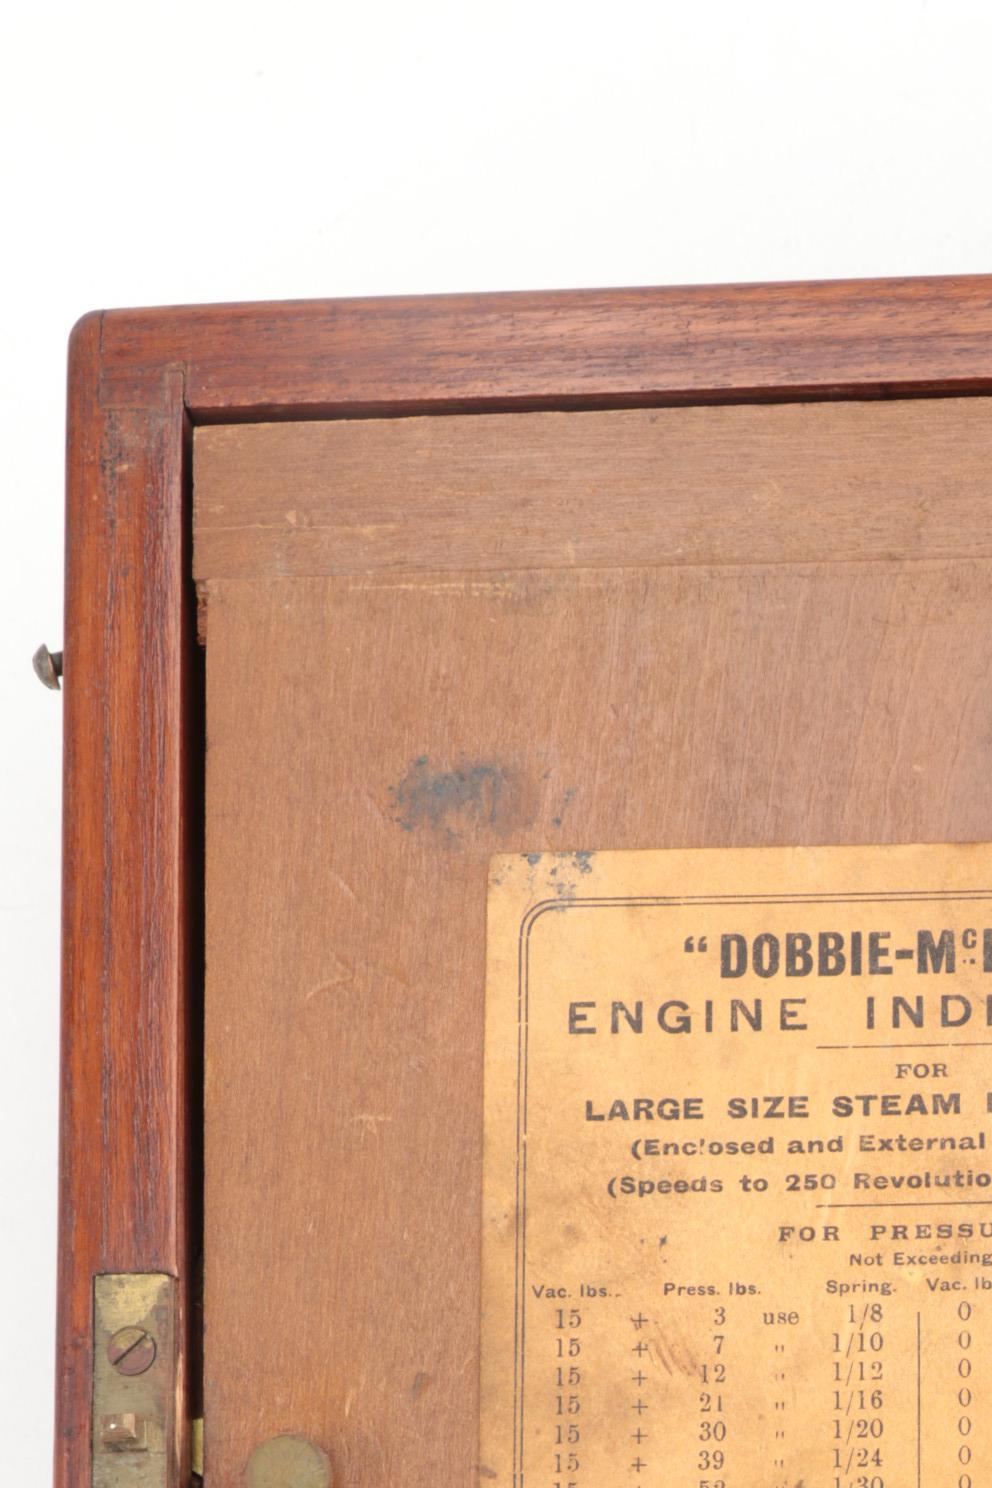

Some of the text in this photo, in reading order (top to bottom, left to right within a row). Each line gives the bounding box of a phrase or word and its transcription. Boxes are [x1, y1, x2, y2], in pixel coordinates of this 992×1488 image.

[569, 998, 807, 1034] ENGINE
[896, 1063, 948, 1079] FOR
[586, 1098, 703, 1121] LARGE
[728, 1096, 809, 1119] SIZE
[833, 1093, 960, 1117] STEAM
[788, 1136, 843, 1154] and
[860, 1132, 985, 1152] External
[607, 1176, 723, 1199] (Speeds
[739, 1175, 768, 1192] to
[786, 1174, 835, 1191] 250
[779, 1226, 839, 1242] FOR
[850, 1253, 882, 1266] Not
[532, 1285, 571, 1298] Vac.
[664, 1283, 720, 1296] Press.
[729, 1282, 760, 1295] lbs.
[826, 1280, 896, 1297] Spring.
[926, 1278, 966, 1291] Vac.
[556, 1309, 581, 1329] 15
[714, 1307, 726, 1325] 3
[763, 1312, 799, 1325] use
[850, 1304, 883, 1330] 1/8
[958, 1301, 971, 1321] 0
[557, 1338, 580, 1357] 15
[714, 1336, 724, 1354] 7
[832, 1332, 883, 1358] 1/10
[958, 1333, 971, 1349] 0
[557, 1367, 580, 1387] 15
[700, 1364, 725, 1384] 12
[833, 1362, 882, 1386] 1/12
[958, 1359, 971, 1378] 0
[556, 1396, 580, 1415] 15
[700, 1392, 722, 1412] 21
[834, 1390, 883, 1415] 1/16
[958, 1389, 971, 1407] 0
[556, 1425, 579, 1444] 15
[699, 1421, 726, 1441] 30
[834, 1418, 883, 1444] 1/20
[958, 1417, 971, 1436] 0
[555, 1453, 579, 1473] 15
[698, 1450, 724, 1470] 39
[833, 1448, 883, 1475] 1/24
[958, 1445, 971, 1465] 0
